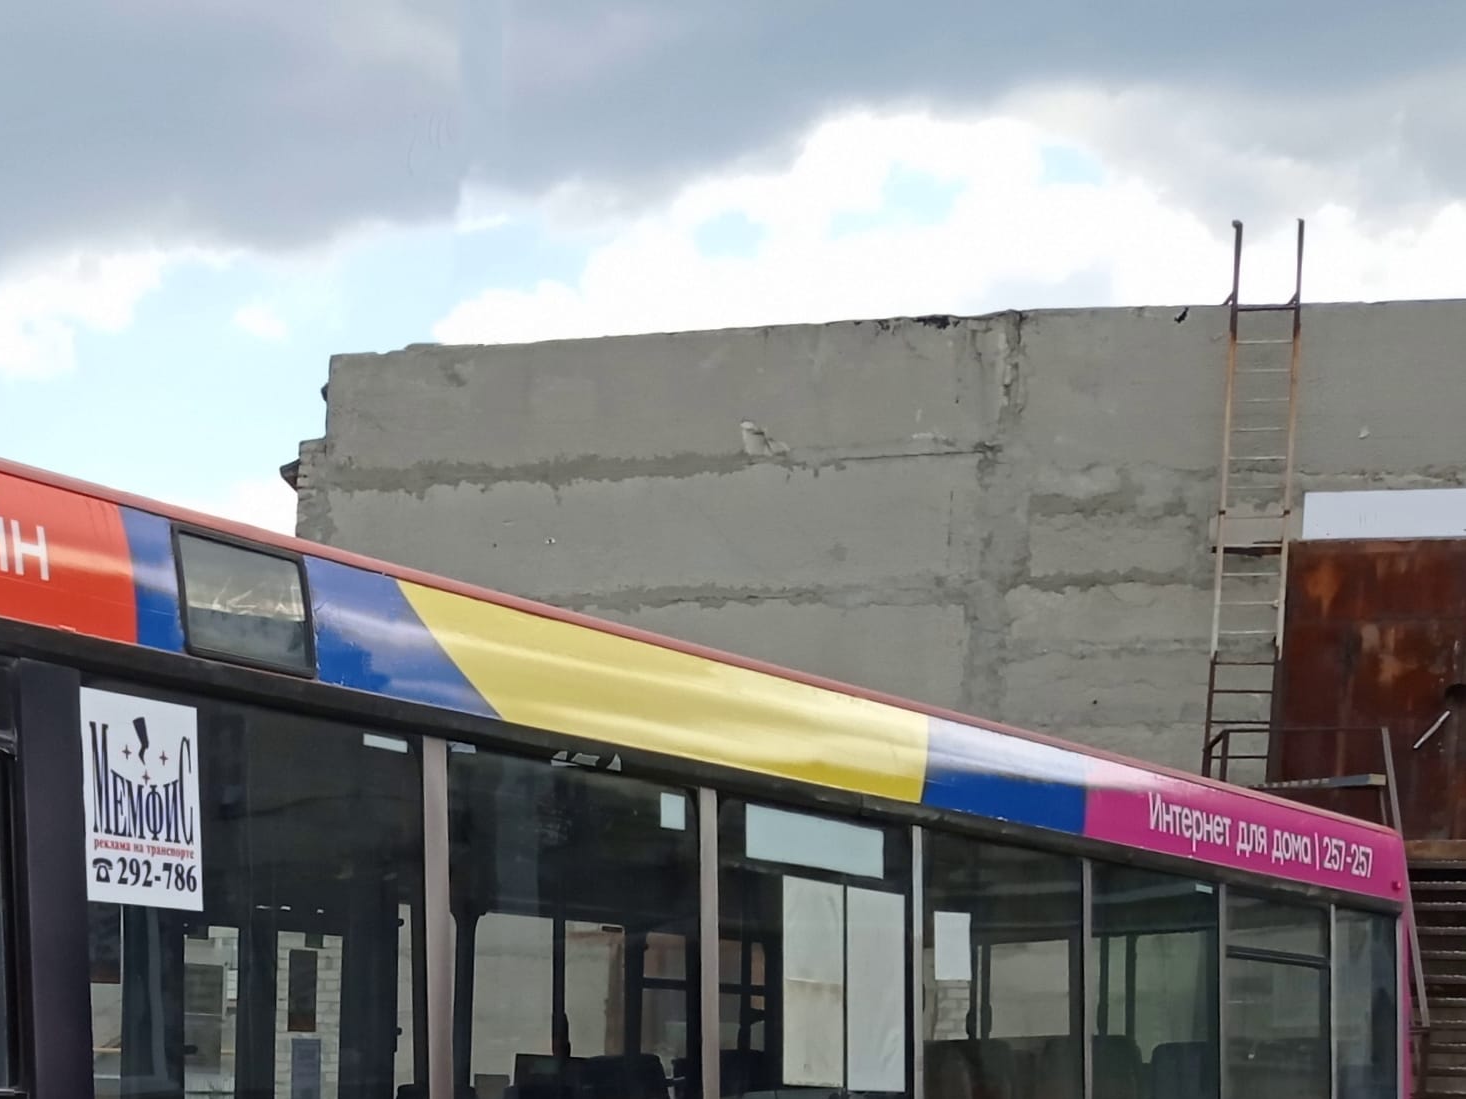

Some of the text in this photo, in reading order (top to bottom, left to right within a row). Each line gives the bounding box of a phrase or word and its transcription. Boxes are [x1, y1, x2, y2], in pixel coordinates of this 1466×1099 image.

[93, 837, 195, 860] реклама на транспорте
[1148, 791, 1232, 853] Интернет
[1237, 820, 1268, 858] для
[1271, 829, 1312, 866] дома
[1322, 836, 1374, 879] 257-257
[117, 856, 198, 893] 292-786
